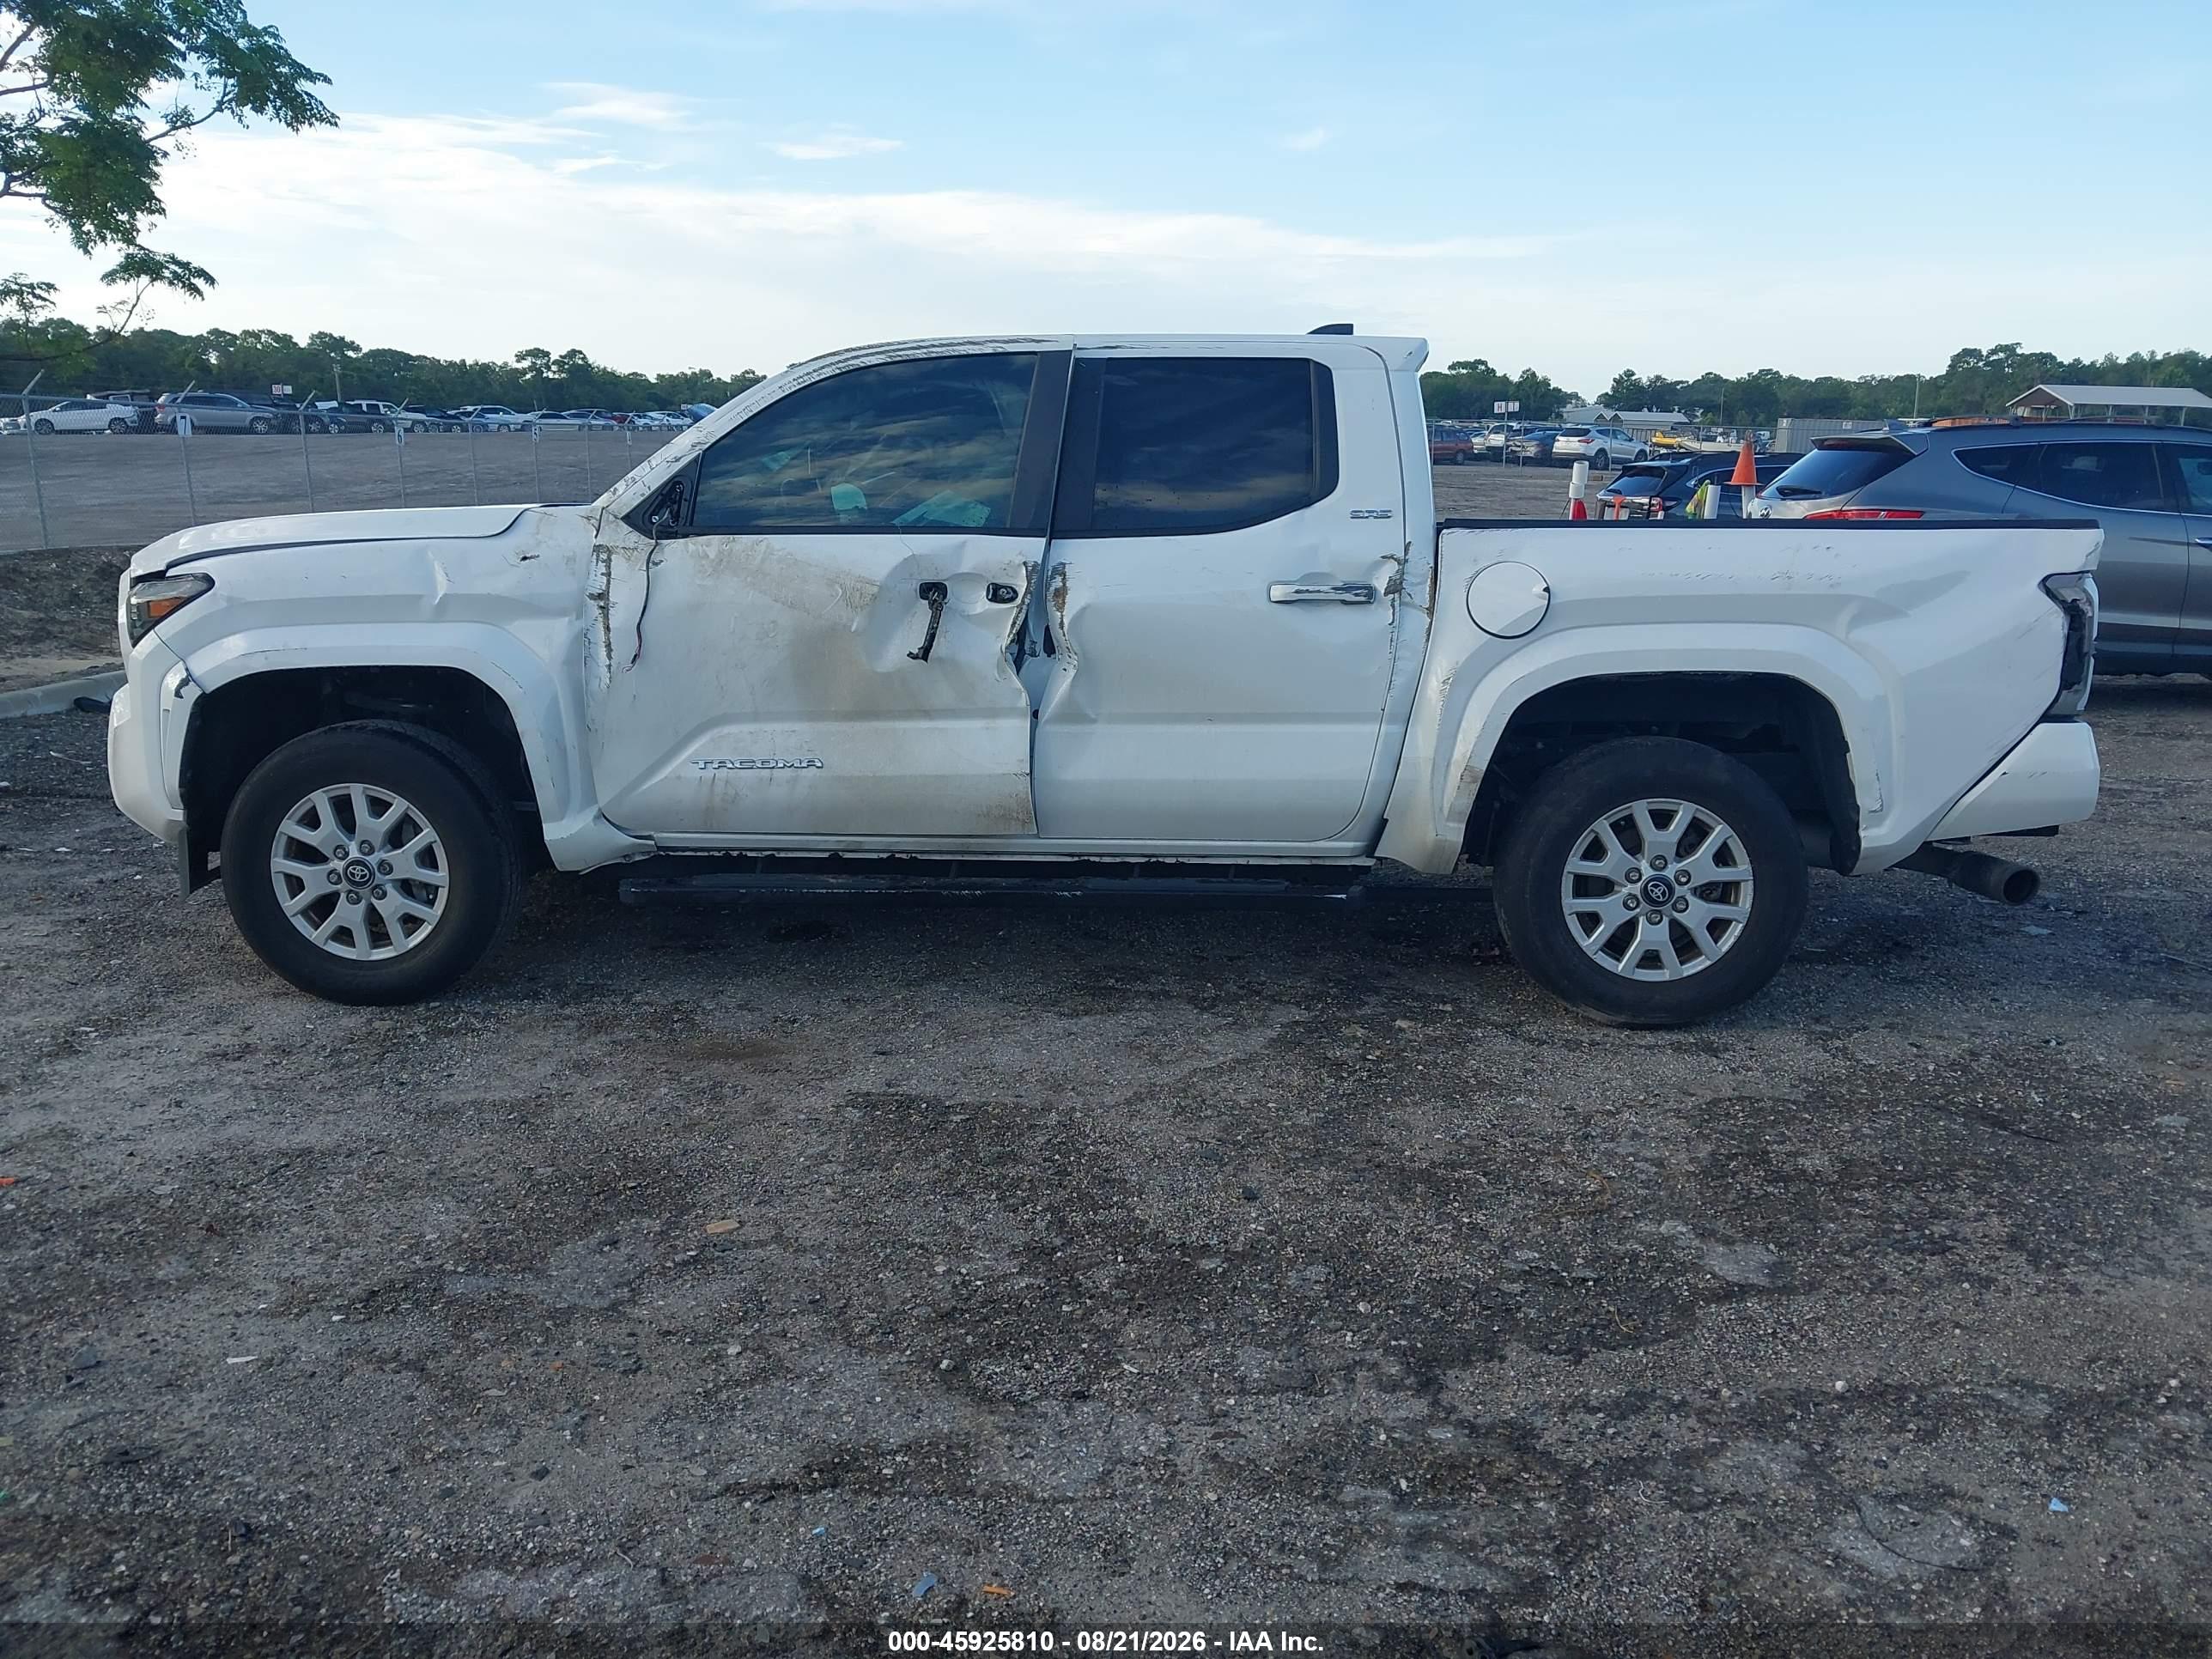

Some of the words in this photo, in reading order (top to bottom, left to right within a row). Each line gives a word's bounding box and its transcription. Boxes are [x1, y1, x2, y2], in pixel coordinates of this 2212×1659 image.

[180, 416, 186, 434] 7
[398, 429, 403, 444] 6
[690, 757, 824, 770] TACOMA
